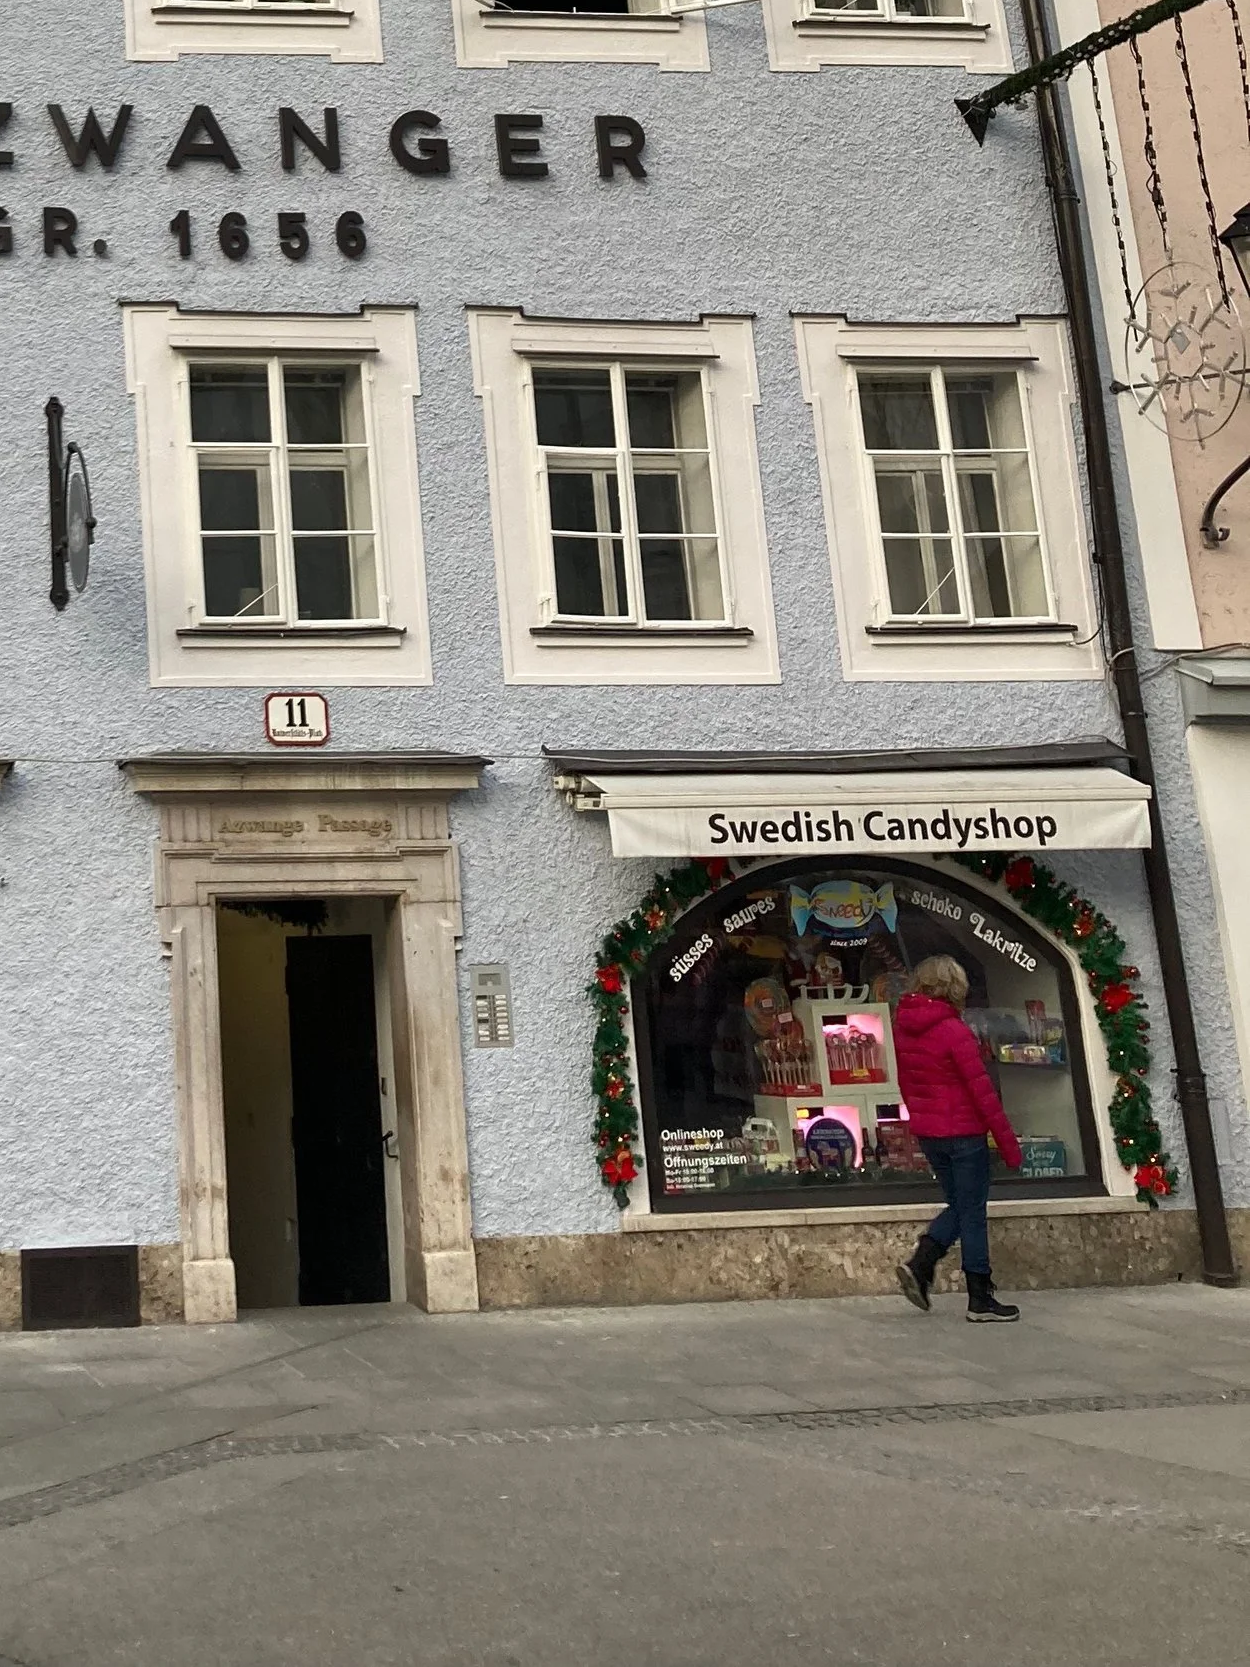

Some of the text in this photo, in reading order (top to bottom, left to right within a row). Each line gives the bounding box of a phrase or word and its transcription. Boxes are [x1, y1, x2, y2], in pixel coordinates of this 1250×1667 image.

[169, 209, 368, 264] 1656
[285, 697, 310, 728] 11
[317, 814, 393, 838] Passage
[708, 807, 1057, 849] Swedish Candyshop
[669, 896, 776, 982] süsses saures
[830, 937, 868, 947] since 2009
[911, 890, 1037, 972] schoko Lakritze
[661, 1128, 724, 1141] Onlineshop
[662, 1141, 724, 1152] www.sweedy.at
[664, 1154, 747, 1168] Öffnungszeiten
